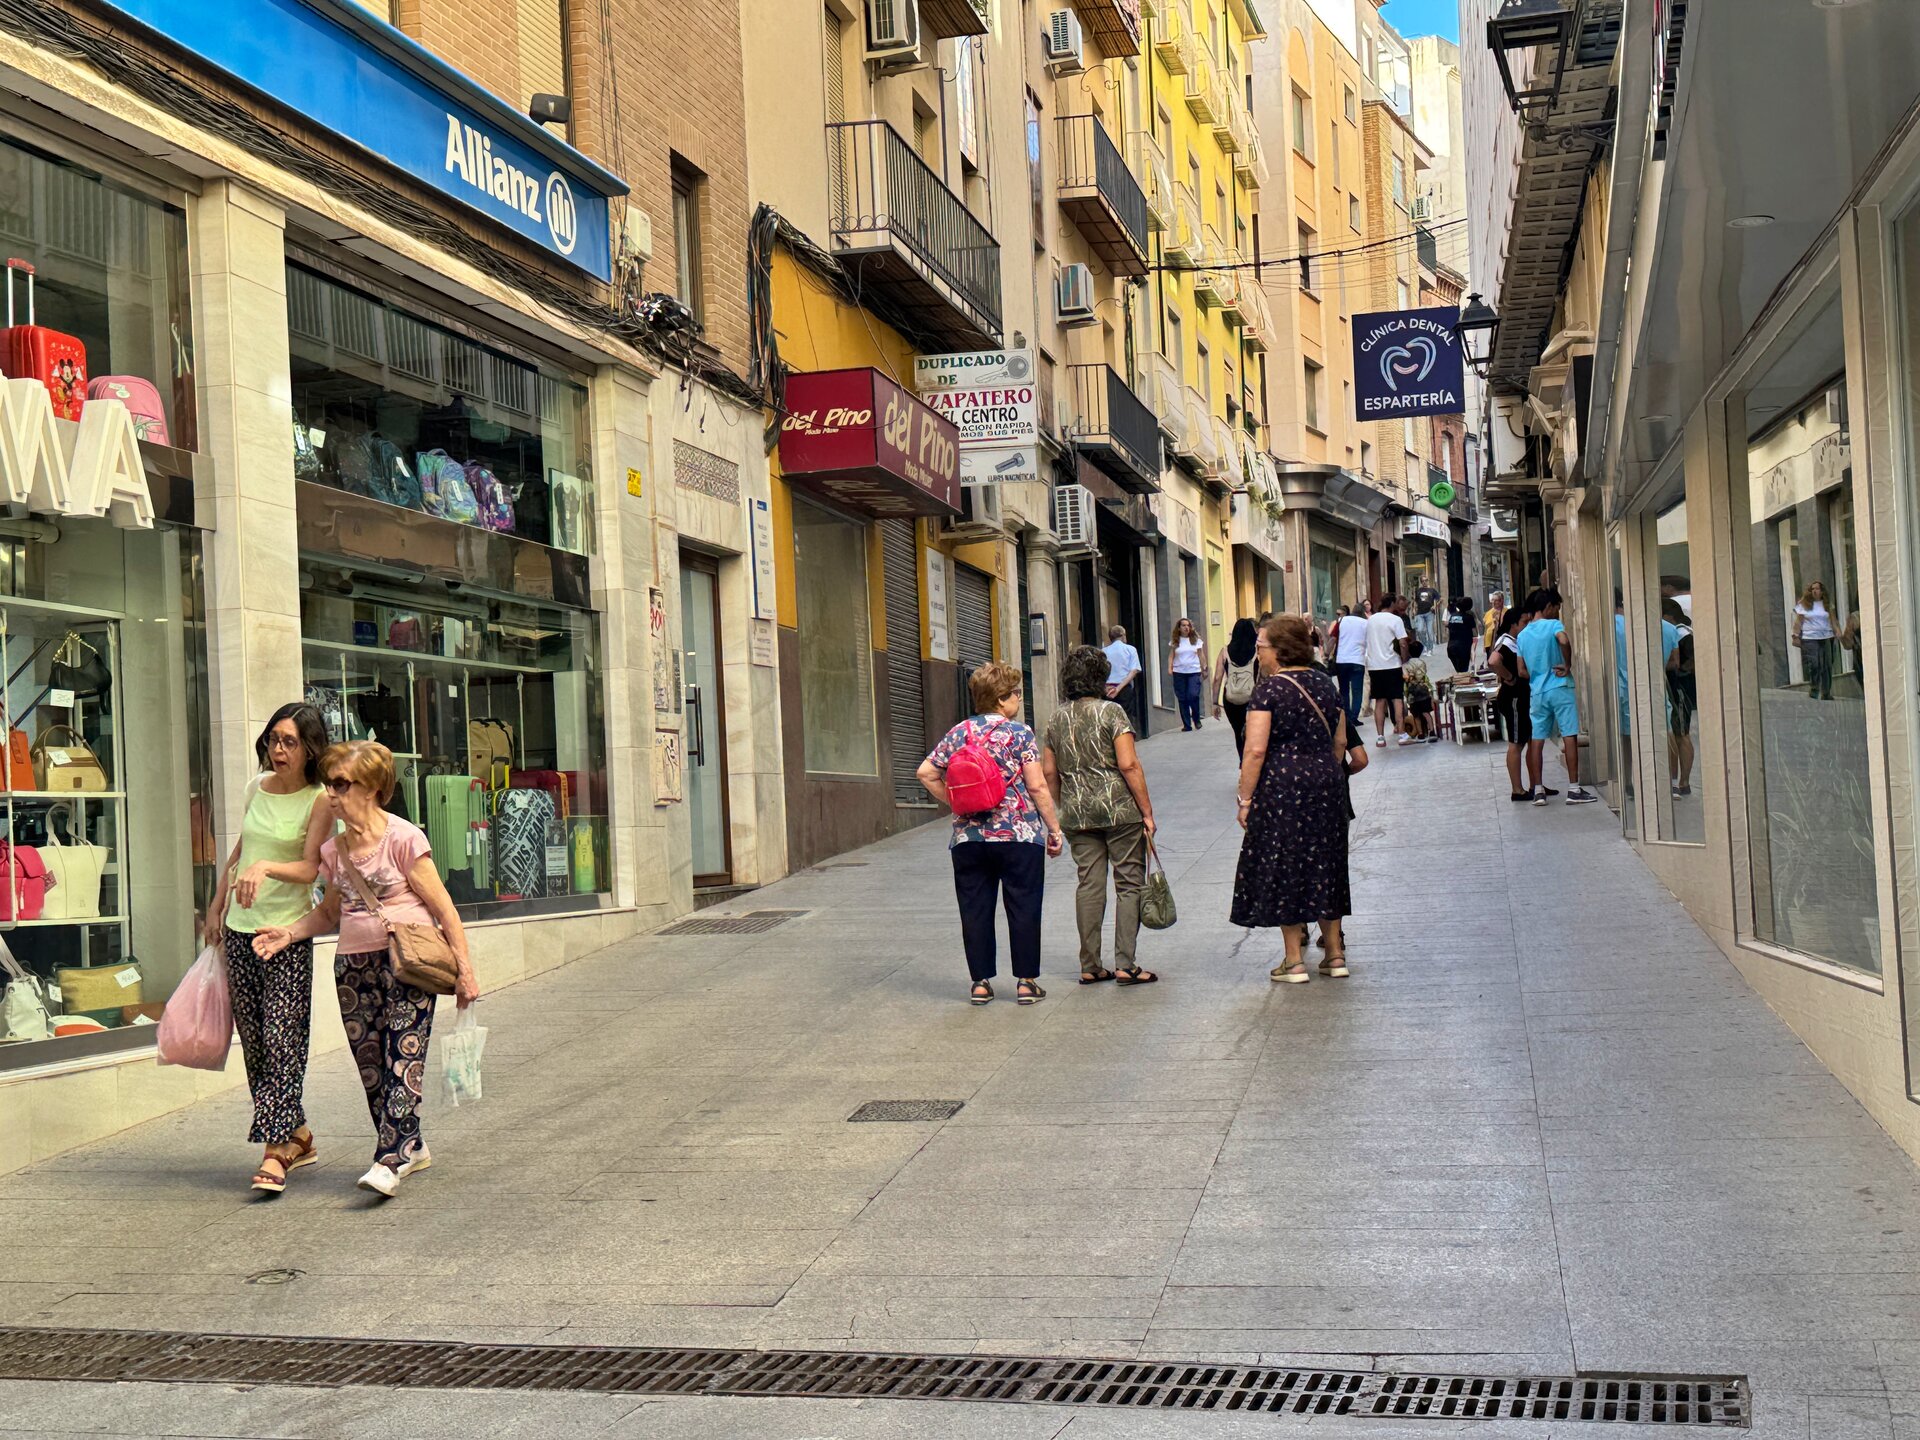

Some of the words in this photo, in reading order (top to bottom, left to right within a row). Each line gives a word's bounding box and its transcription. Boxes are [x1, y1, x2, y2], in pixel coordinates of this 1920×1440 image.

[446, 113, 542, 223] Allianz
[1360, 320, 1406, 352] CLÍNICA
[1409, 318, 1455, 347] DENTAL
[918, 354, 1006, 370] DUPLICADO
[937, 374, 958, 386] DE
[927, 388, 1033, 410] ZAPATERO
[1364, 389, 1456, 411] ESPARTERÍA
[782, 410, 818, 431] del
[823, 407, 872, 427] Pino
[962, 406, 1018, 425] CENTRO
[995, 421, 1033, 430] RAPIDA
[884, 391, 914, 456] del
[918, 411, 956, 481] Pino
[504, 843, 532, 882] LOIS
